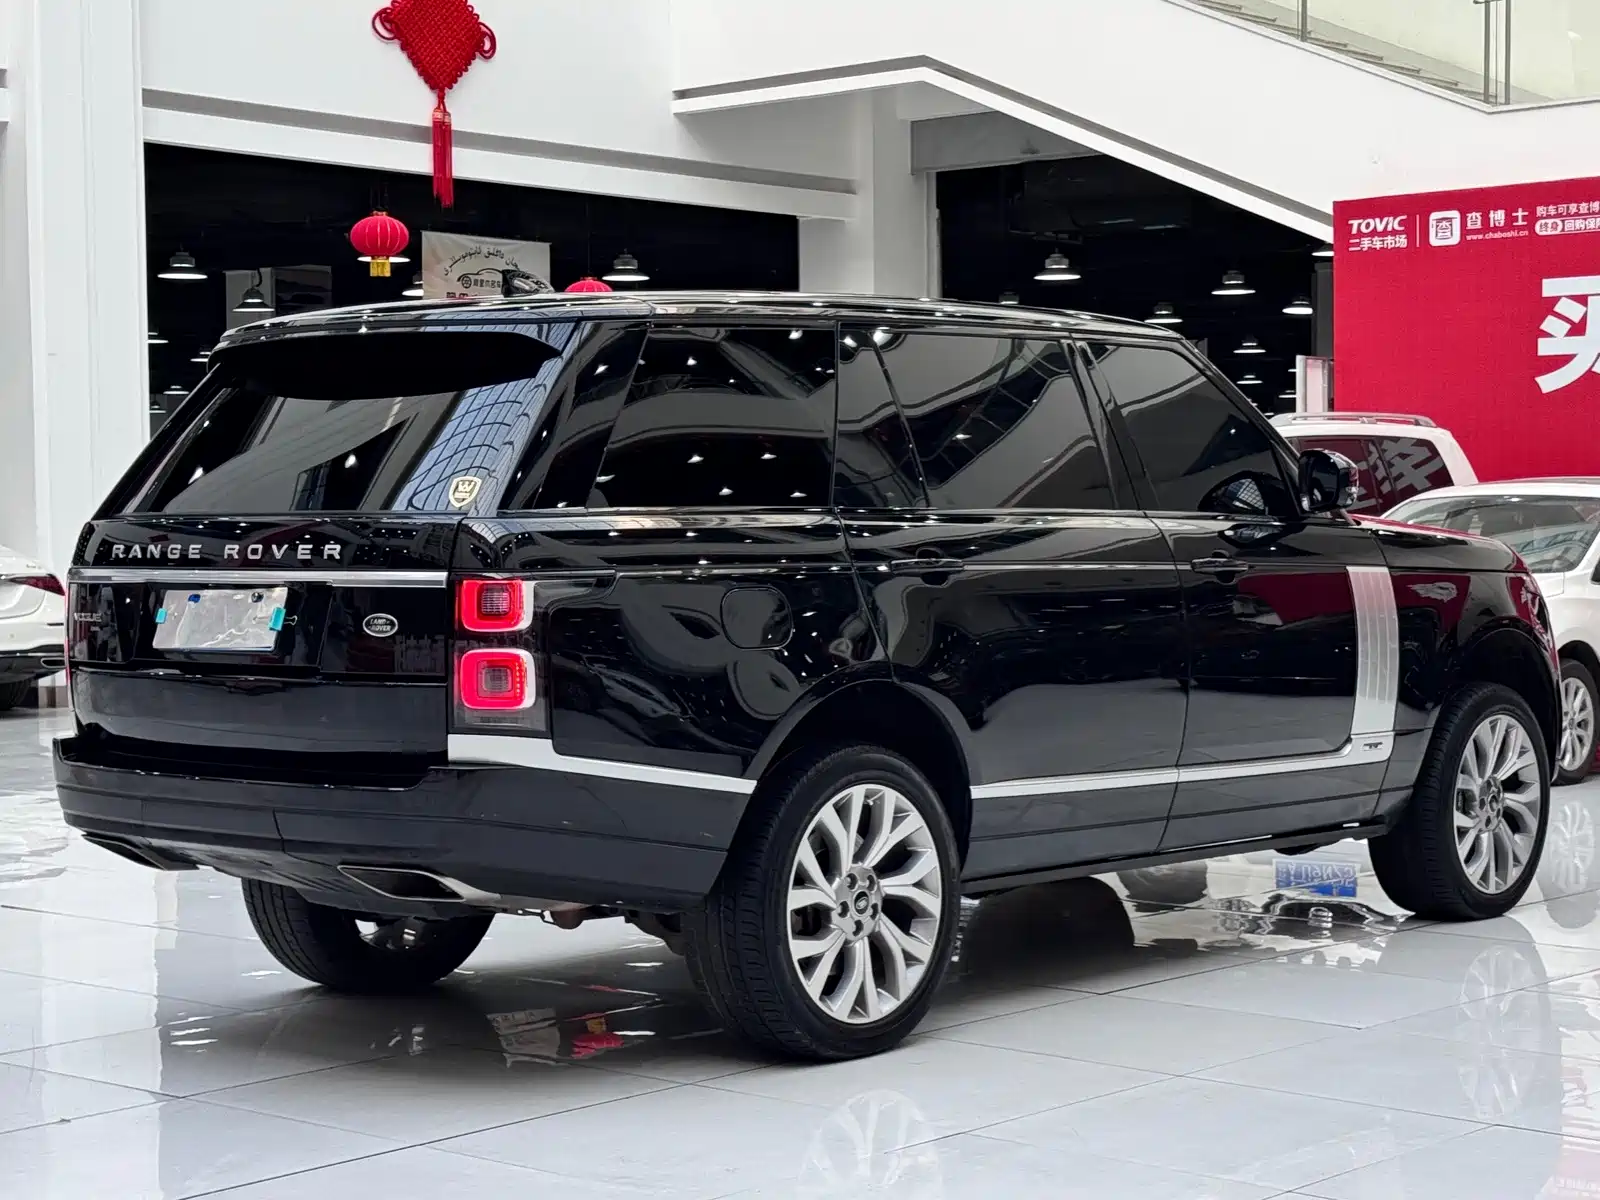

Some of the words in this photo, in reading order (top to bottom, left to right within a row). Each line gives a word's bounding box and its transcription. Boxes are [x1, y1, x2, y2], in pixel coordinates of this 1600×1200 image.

[1348, 215, 1407, 235] TOVIC
[1466, 208, 1529, 230] 查博士
[1348, 234, 1408, 252] 二手车市场
[1466, 229, 1529, 241] www.chaboshi.cn
[111, 543, 203, 560] RANGE
[223, 543, 342, 560] ROVER
